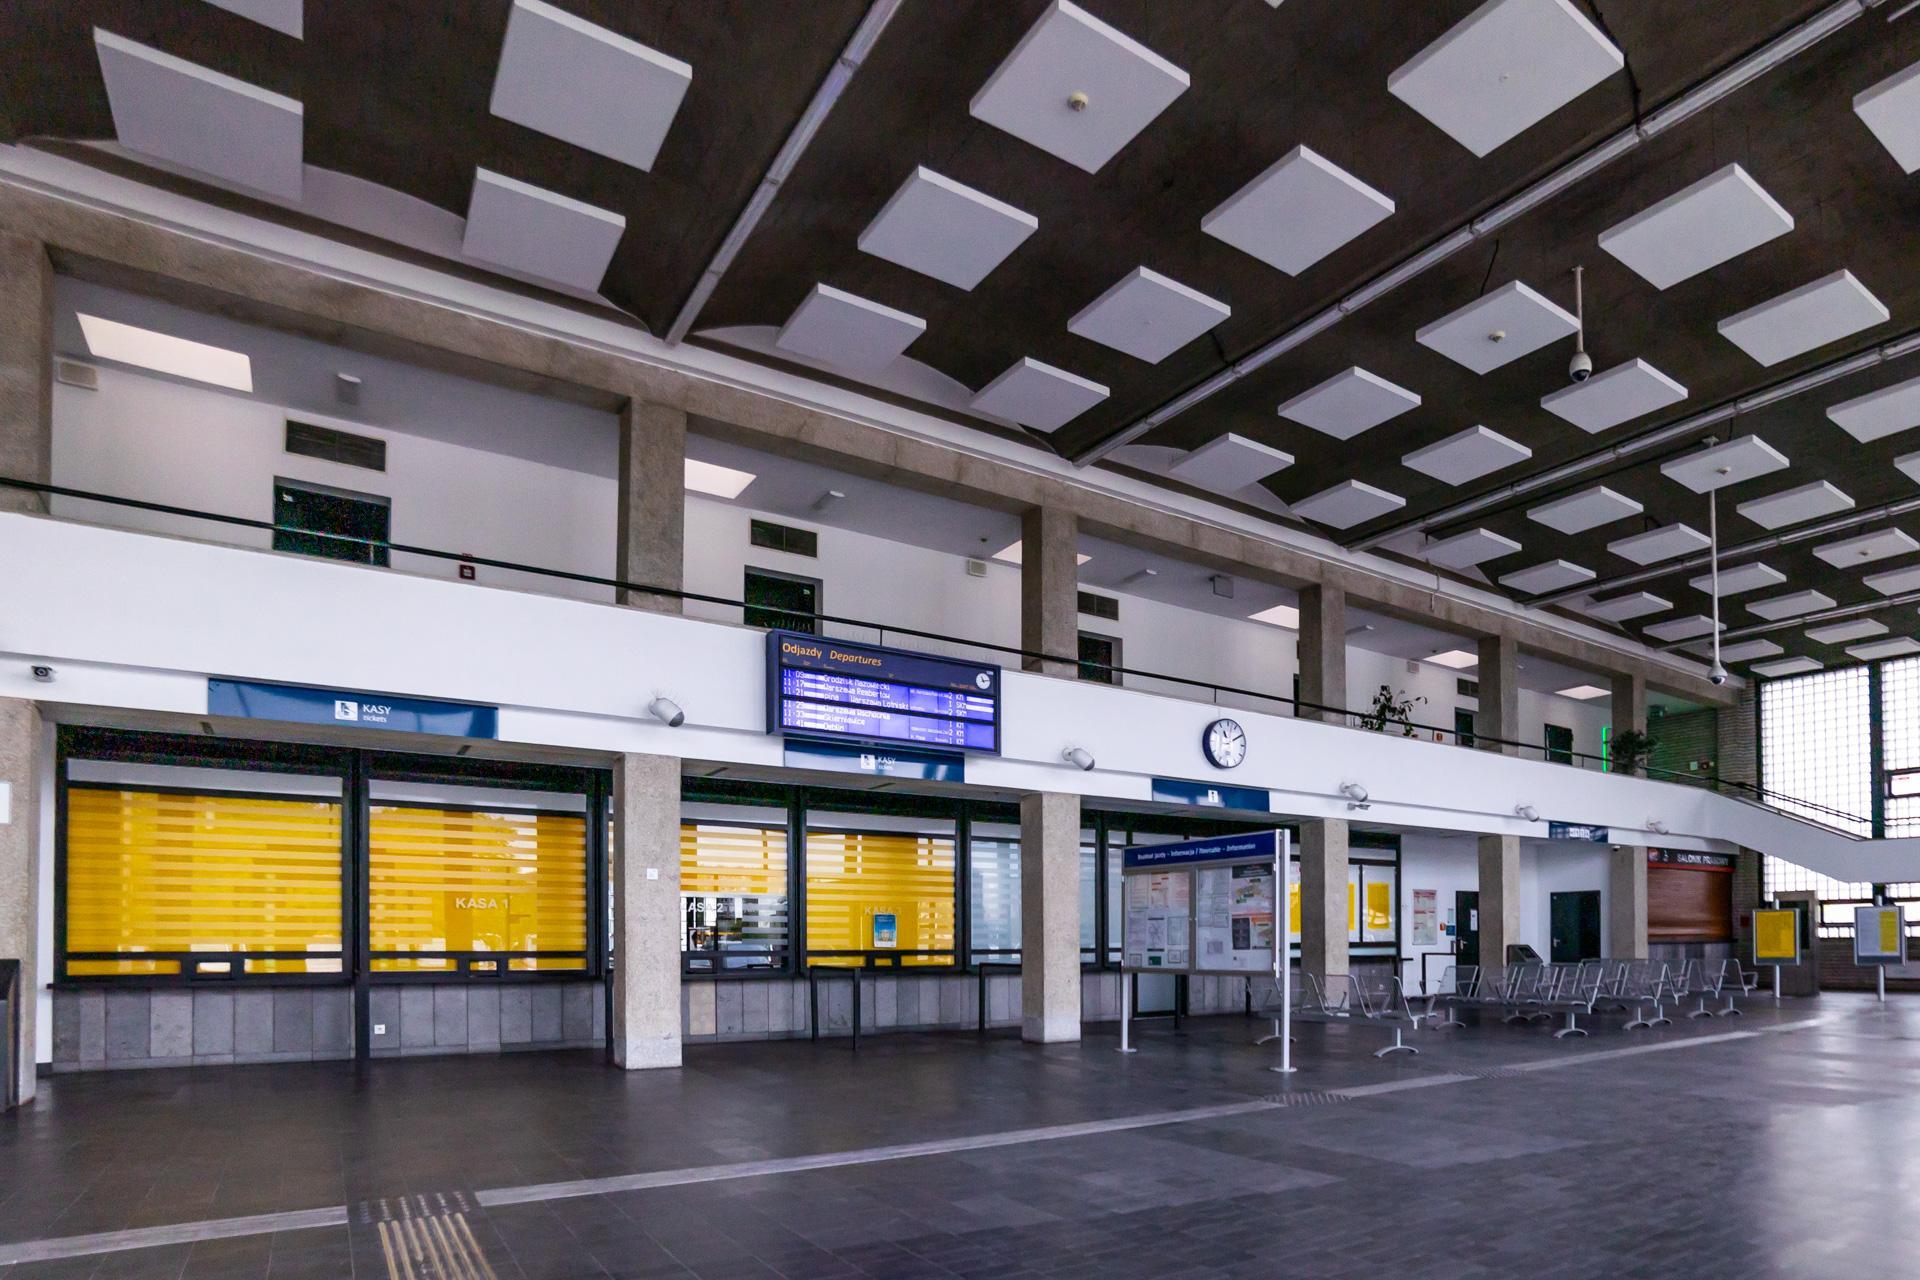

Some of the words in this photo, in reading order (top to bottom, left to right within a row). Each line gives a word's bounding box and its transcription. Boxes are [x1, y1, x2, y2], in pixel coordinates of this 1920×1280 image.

[782, 643, 822, 659] Odjazdy
[830, 650, 882, 666] Departures
[363, 704, 391, 715] KASY
[878, 756, 896, 764] KASY
[455, 897, 498, 909] KASA
[717, 902, 723, 913] 2
